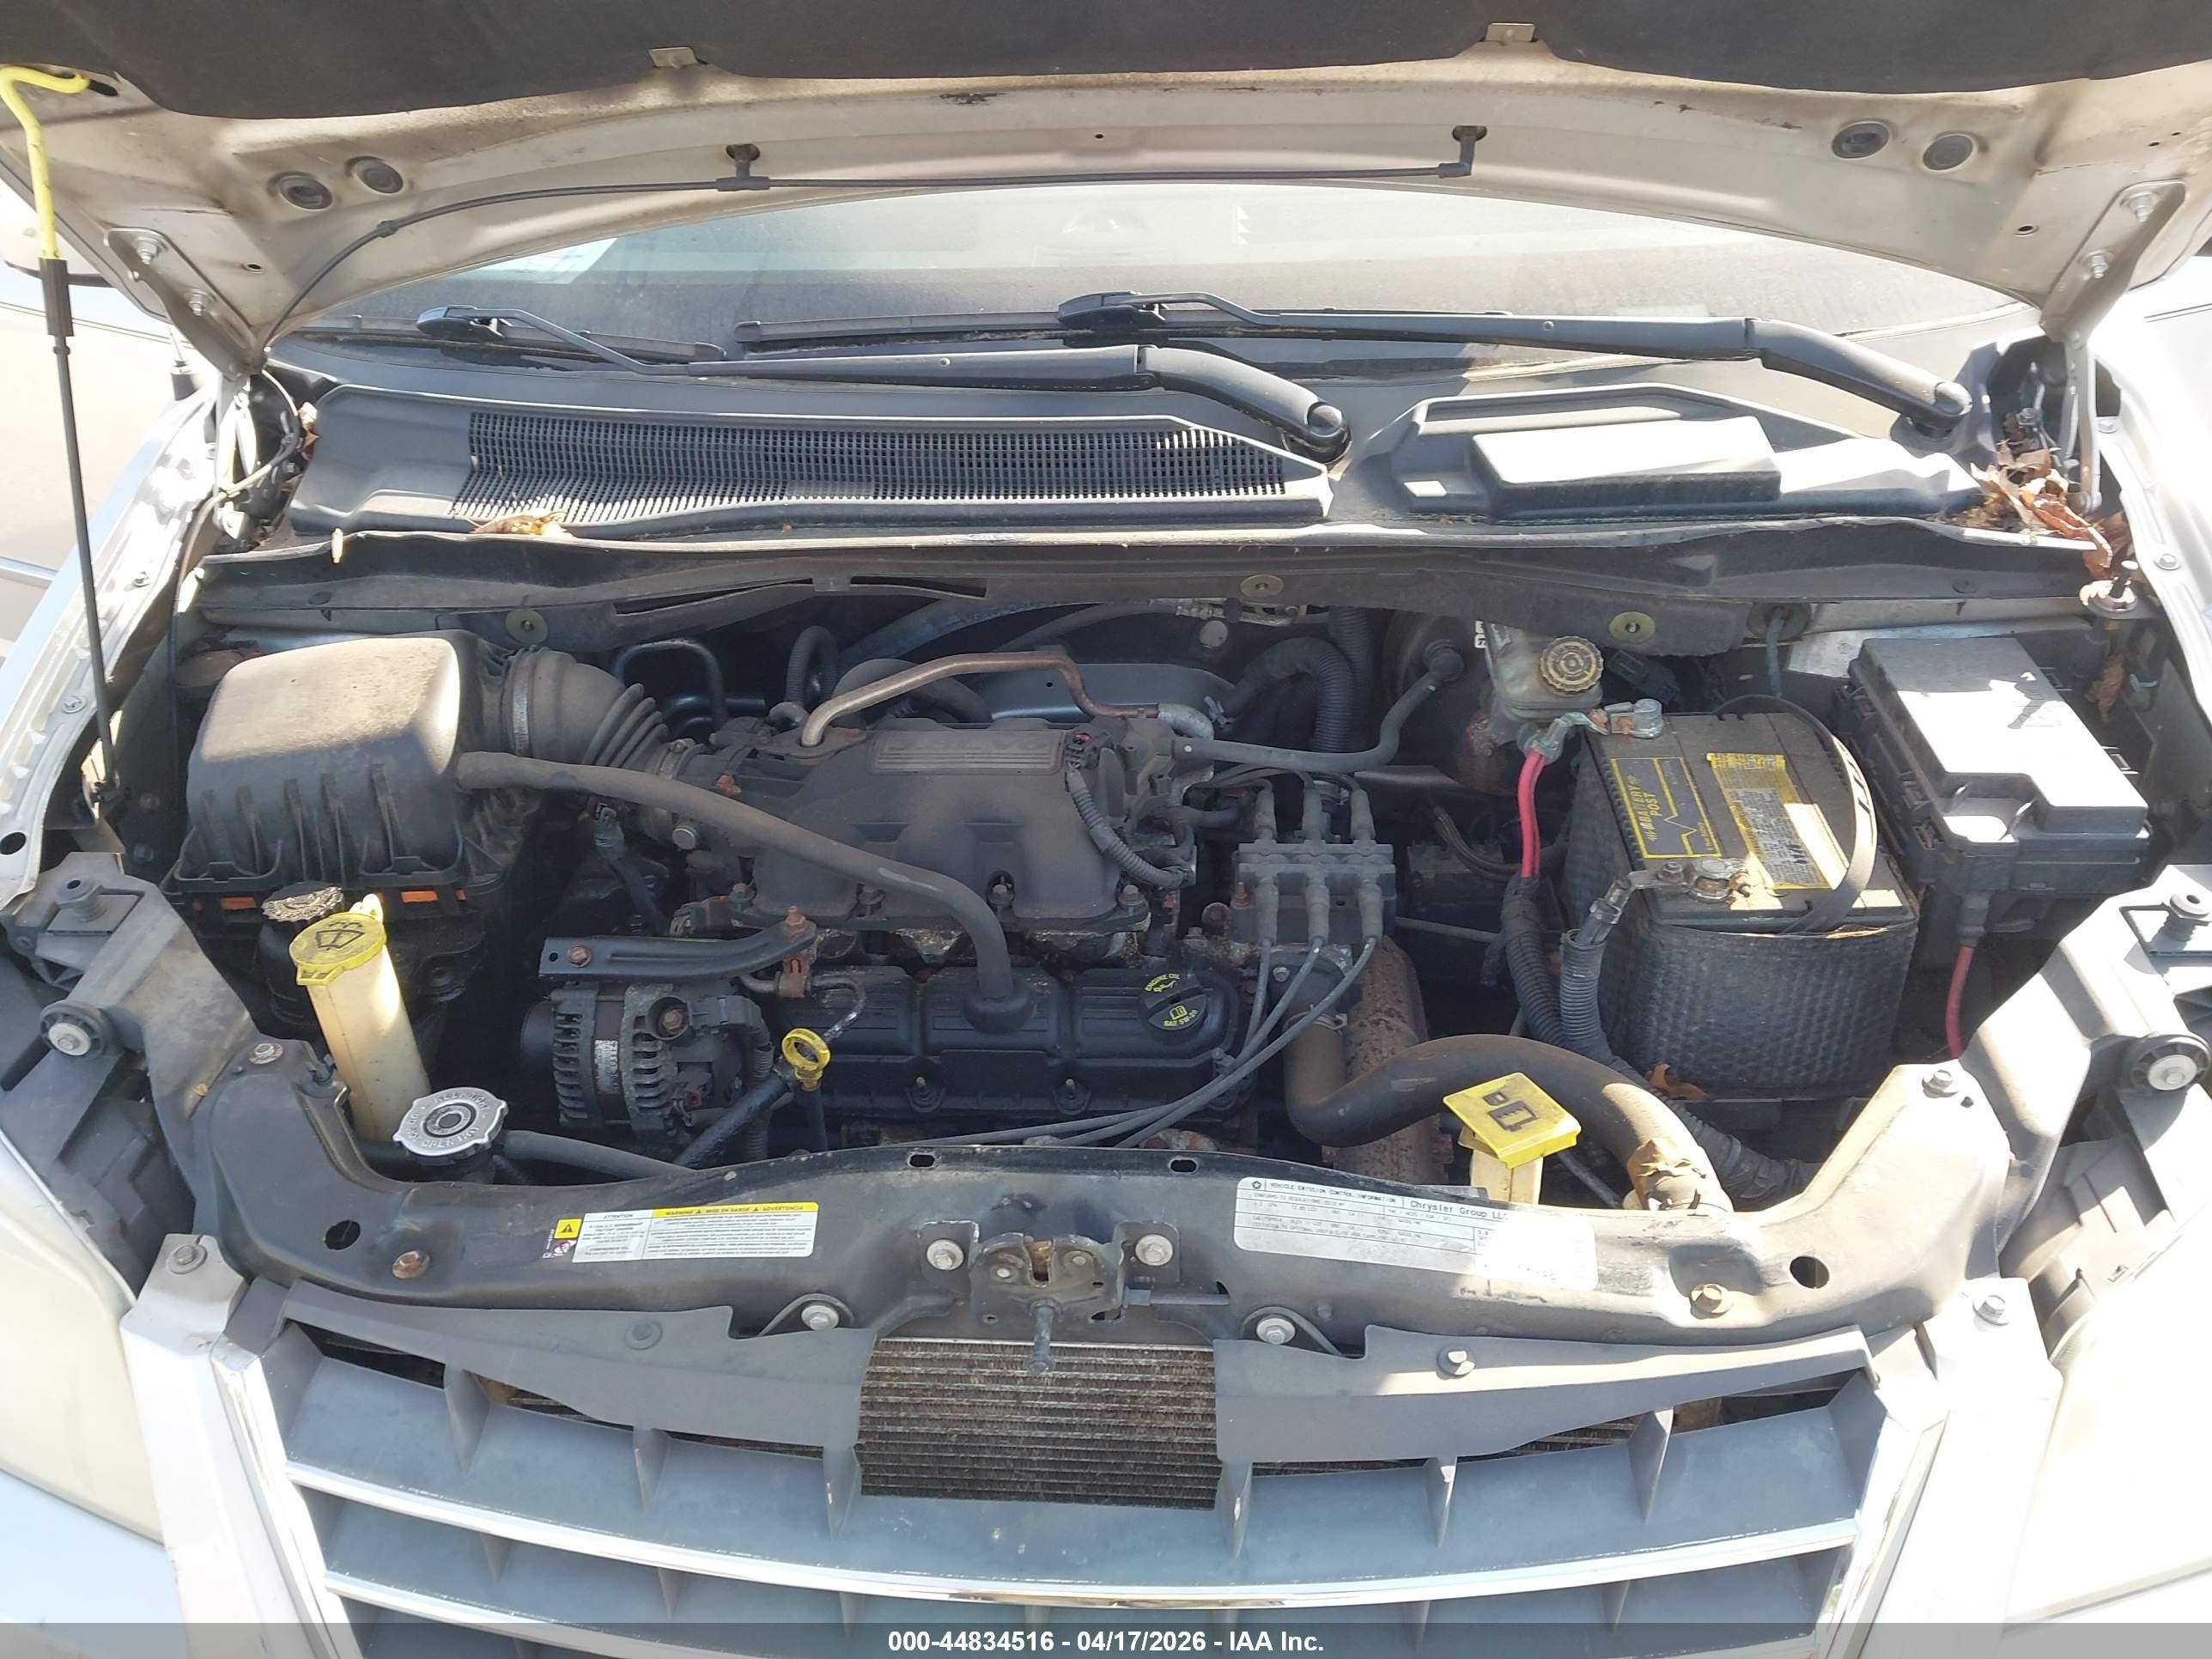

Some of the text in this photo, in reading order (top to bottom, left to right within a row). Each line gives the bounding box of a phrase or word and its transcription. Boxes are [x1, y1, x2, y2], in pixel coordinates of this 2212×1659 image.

[1642, 792, 1662, 817] POST
[1145, 974, 1168, 992] ENGINE
[1410, 1200, 1454, 1212] Chrysler
[1459, 1207, 1487, 1218] Group
